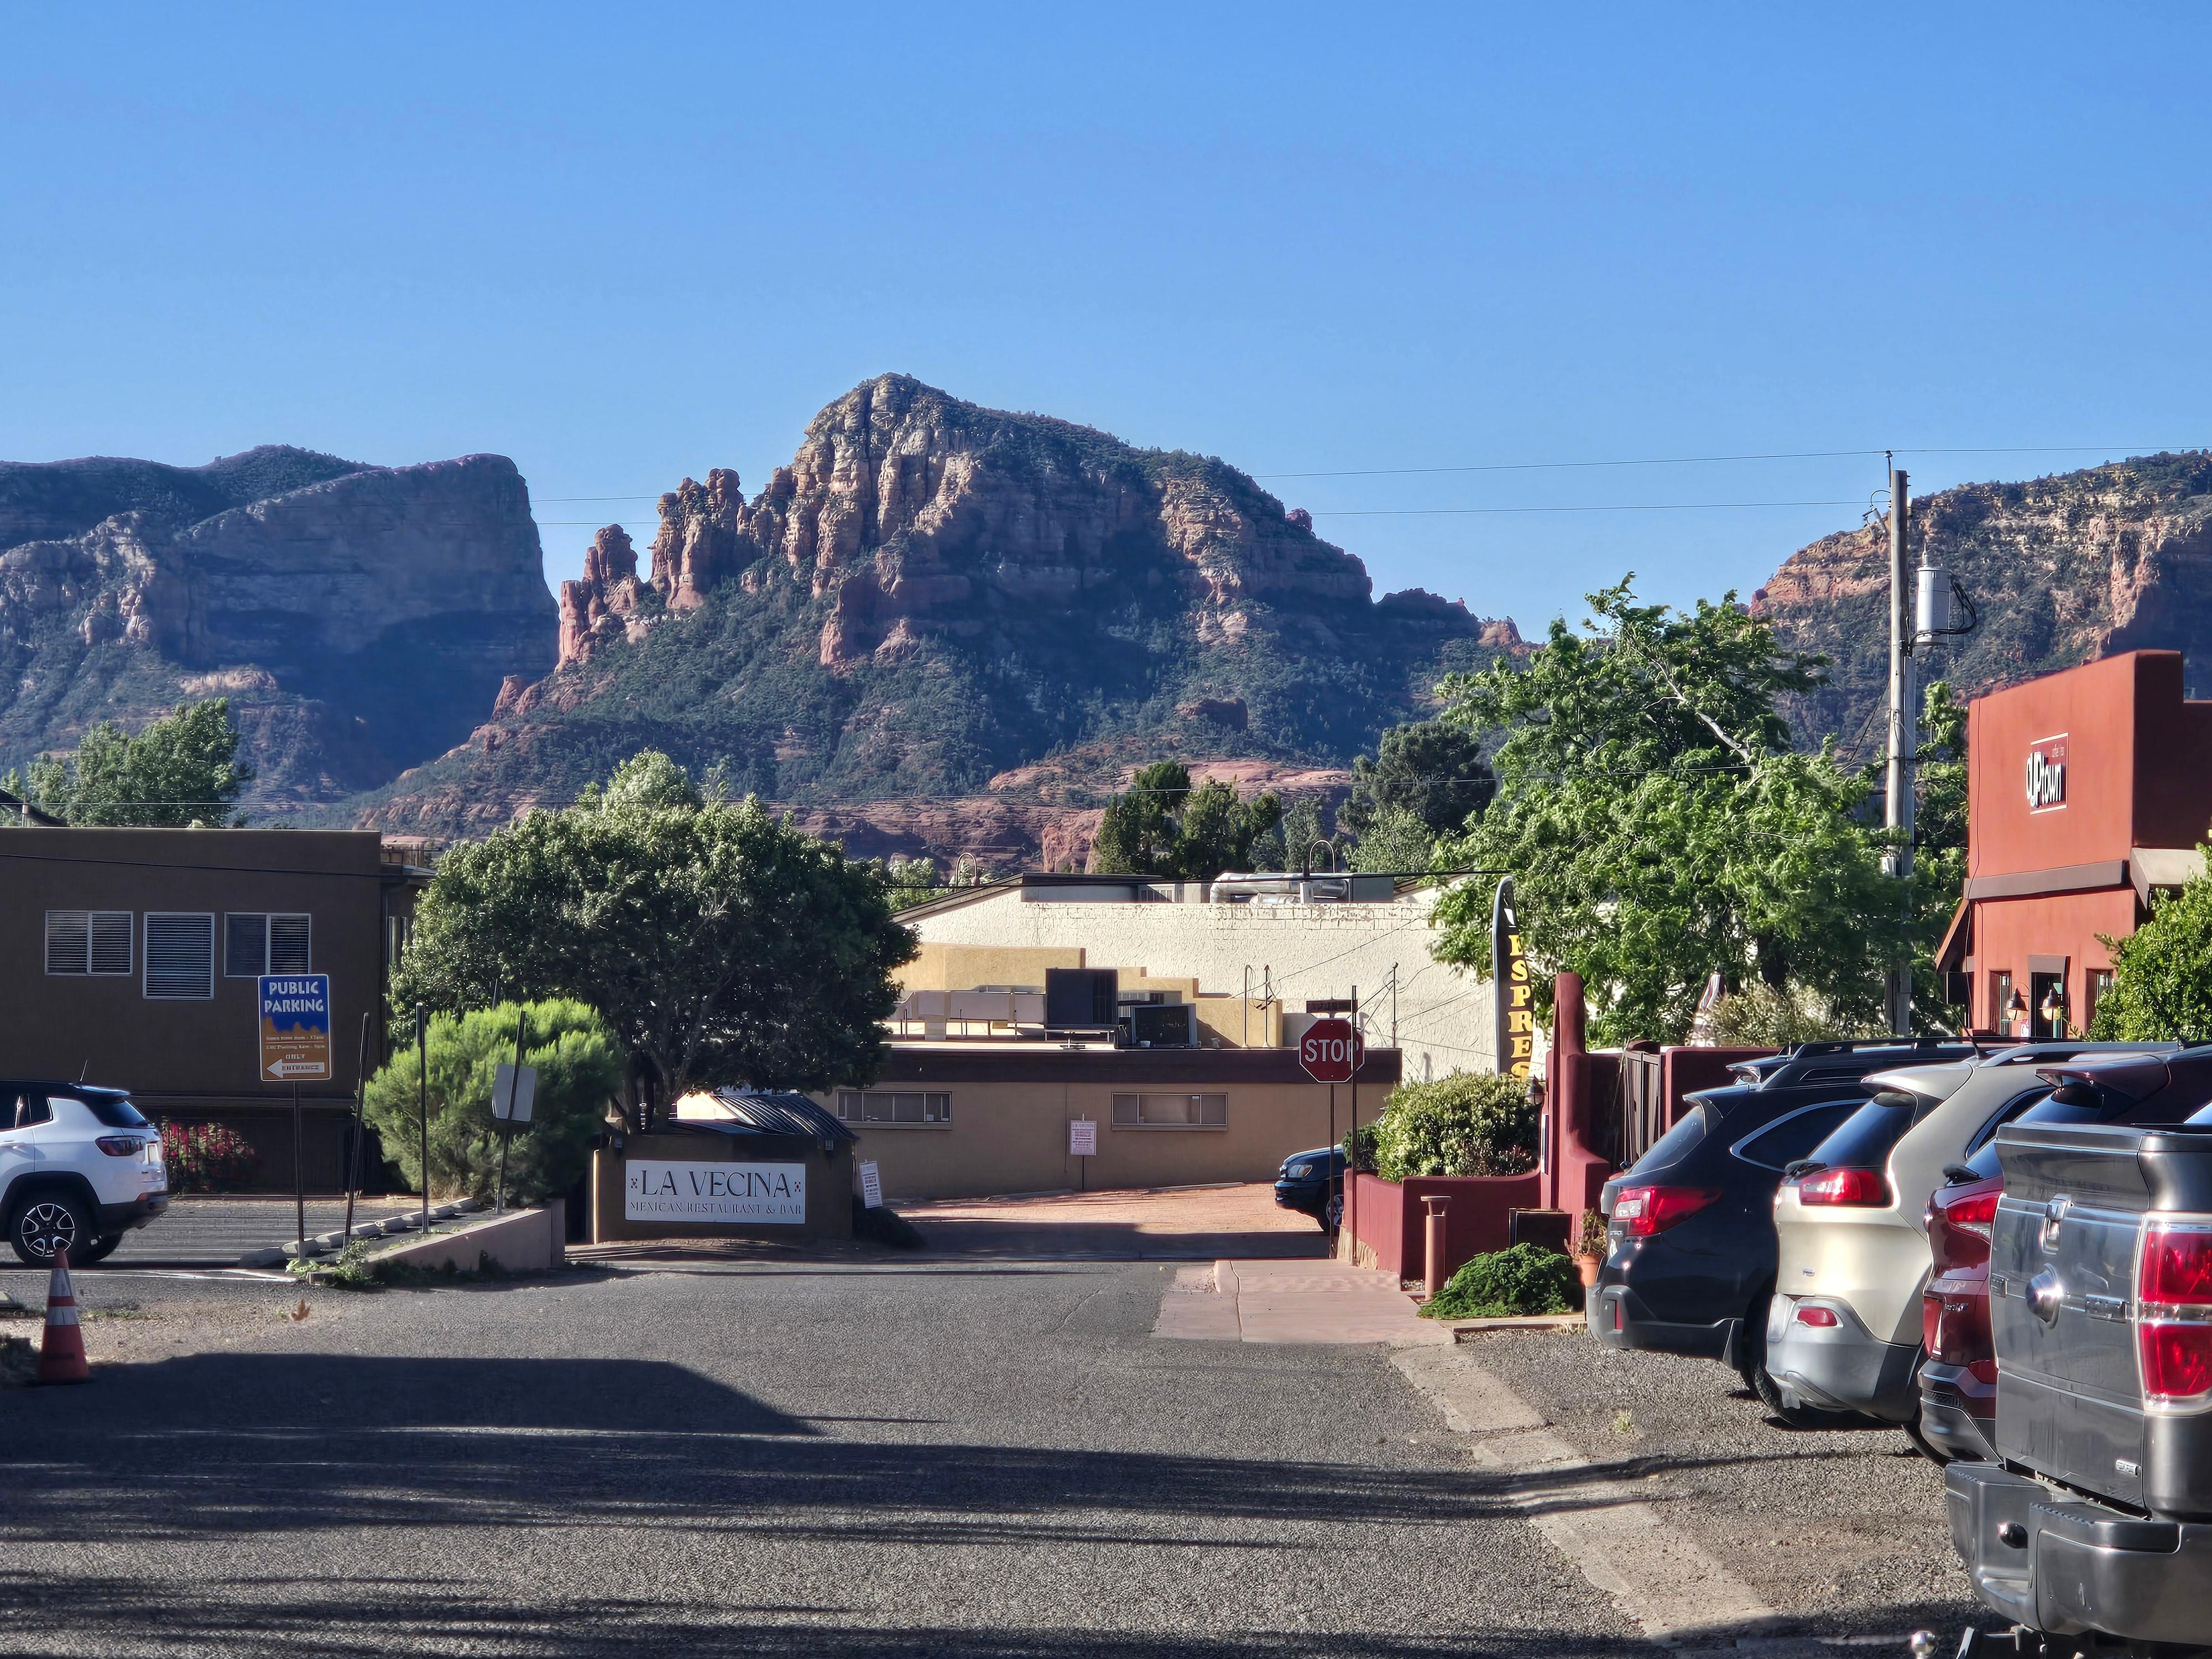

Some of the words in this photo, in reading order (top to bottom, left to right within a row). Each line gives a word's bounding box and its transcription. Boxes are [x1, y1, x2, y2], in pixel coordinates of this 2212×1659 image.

[268, 982, 319, 995] PUBLIC
[264, 999, 324, 1013] PARKING
[1305, 1039, 1359, 1062] STOP
[641, 1170, 678, 1196] LA
[688, 1171, 791, 1198] VECINA
[630, 1202, 683, 1213] MEXICAN
[687, 1202, 761, 1214] RESTAURANT
[766, 1205, 775, 1214] &
[780, 1205, 802, 1214] BAR
